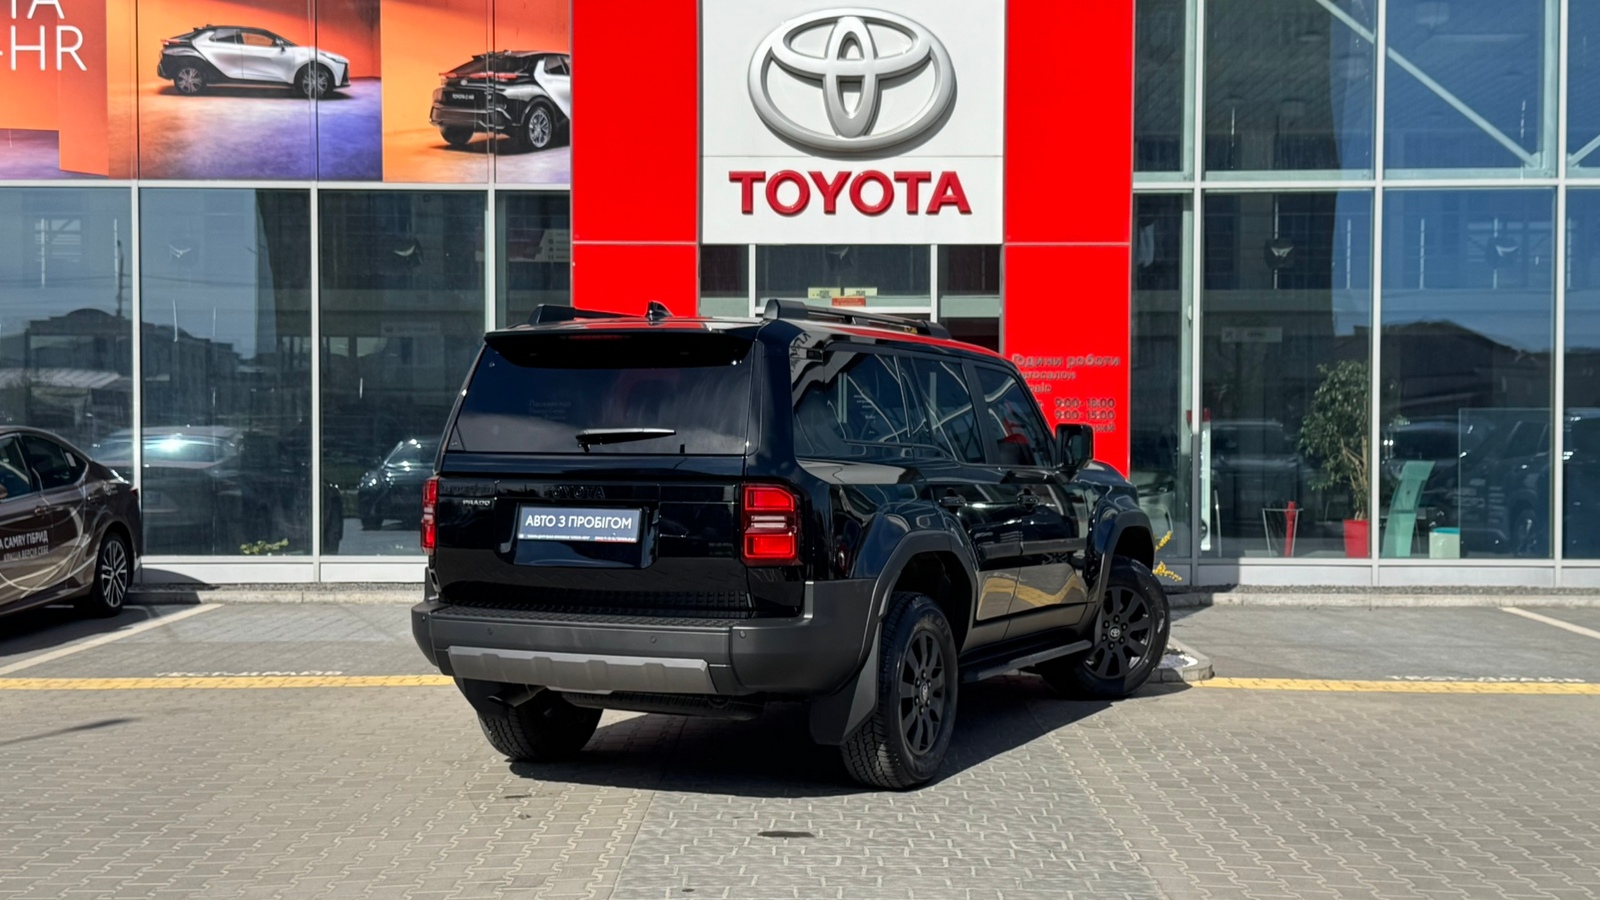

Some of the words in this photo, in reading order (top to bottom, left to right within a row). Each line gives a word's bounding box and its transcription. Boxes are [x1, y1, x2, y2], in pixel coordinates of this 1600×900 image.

[0, 25, 87, 71] HR
[729, 170, 973, 217] TOYOTA
[1067, 353, 1121, 369] роботи
[1020, 371, 1076, 380] втосалон
[543, 485, 606, 499] TOYOTA
[525, 514, 556, 527] АВТО
[558, 515, 566, 528] З
[568, 515, 633, 530] ПРОБІГОМ
[4, 534, 26, 549] CAMRY
